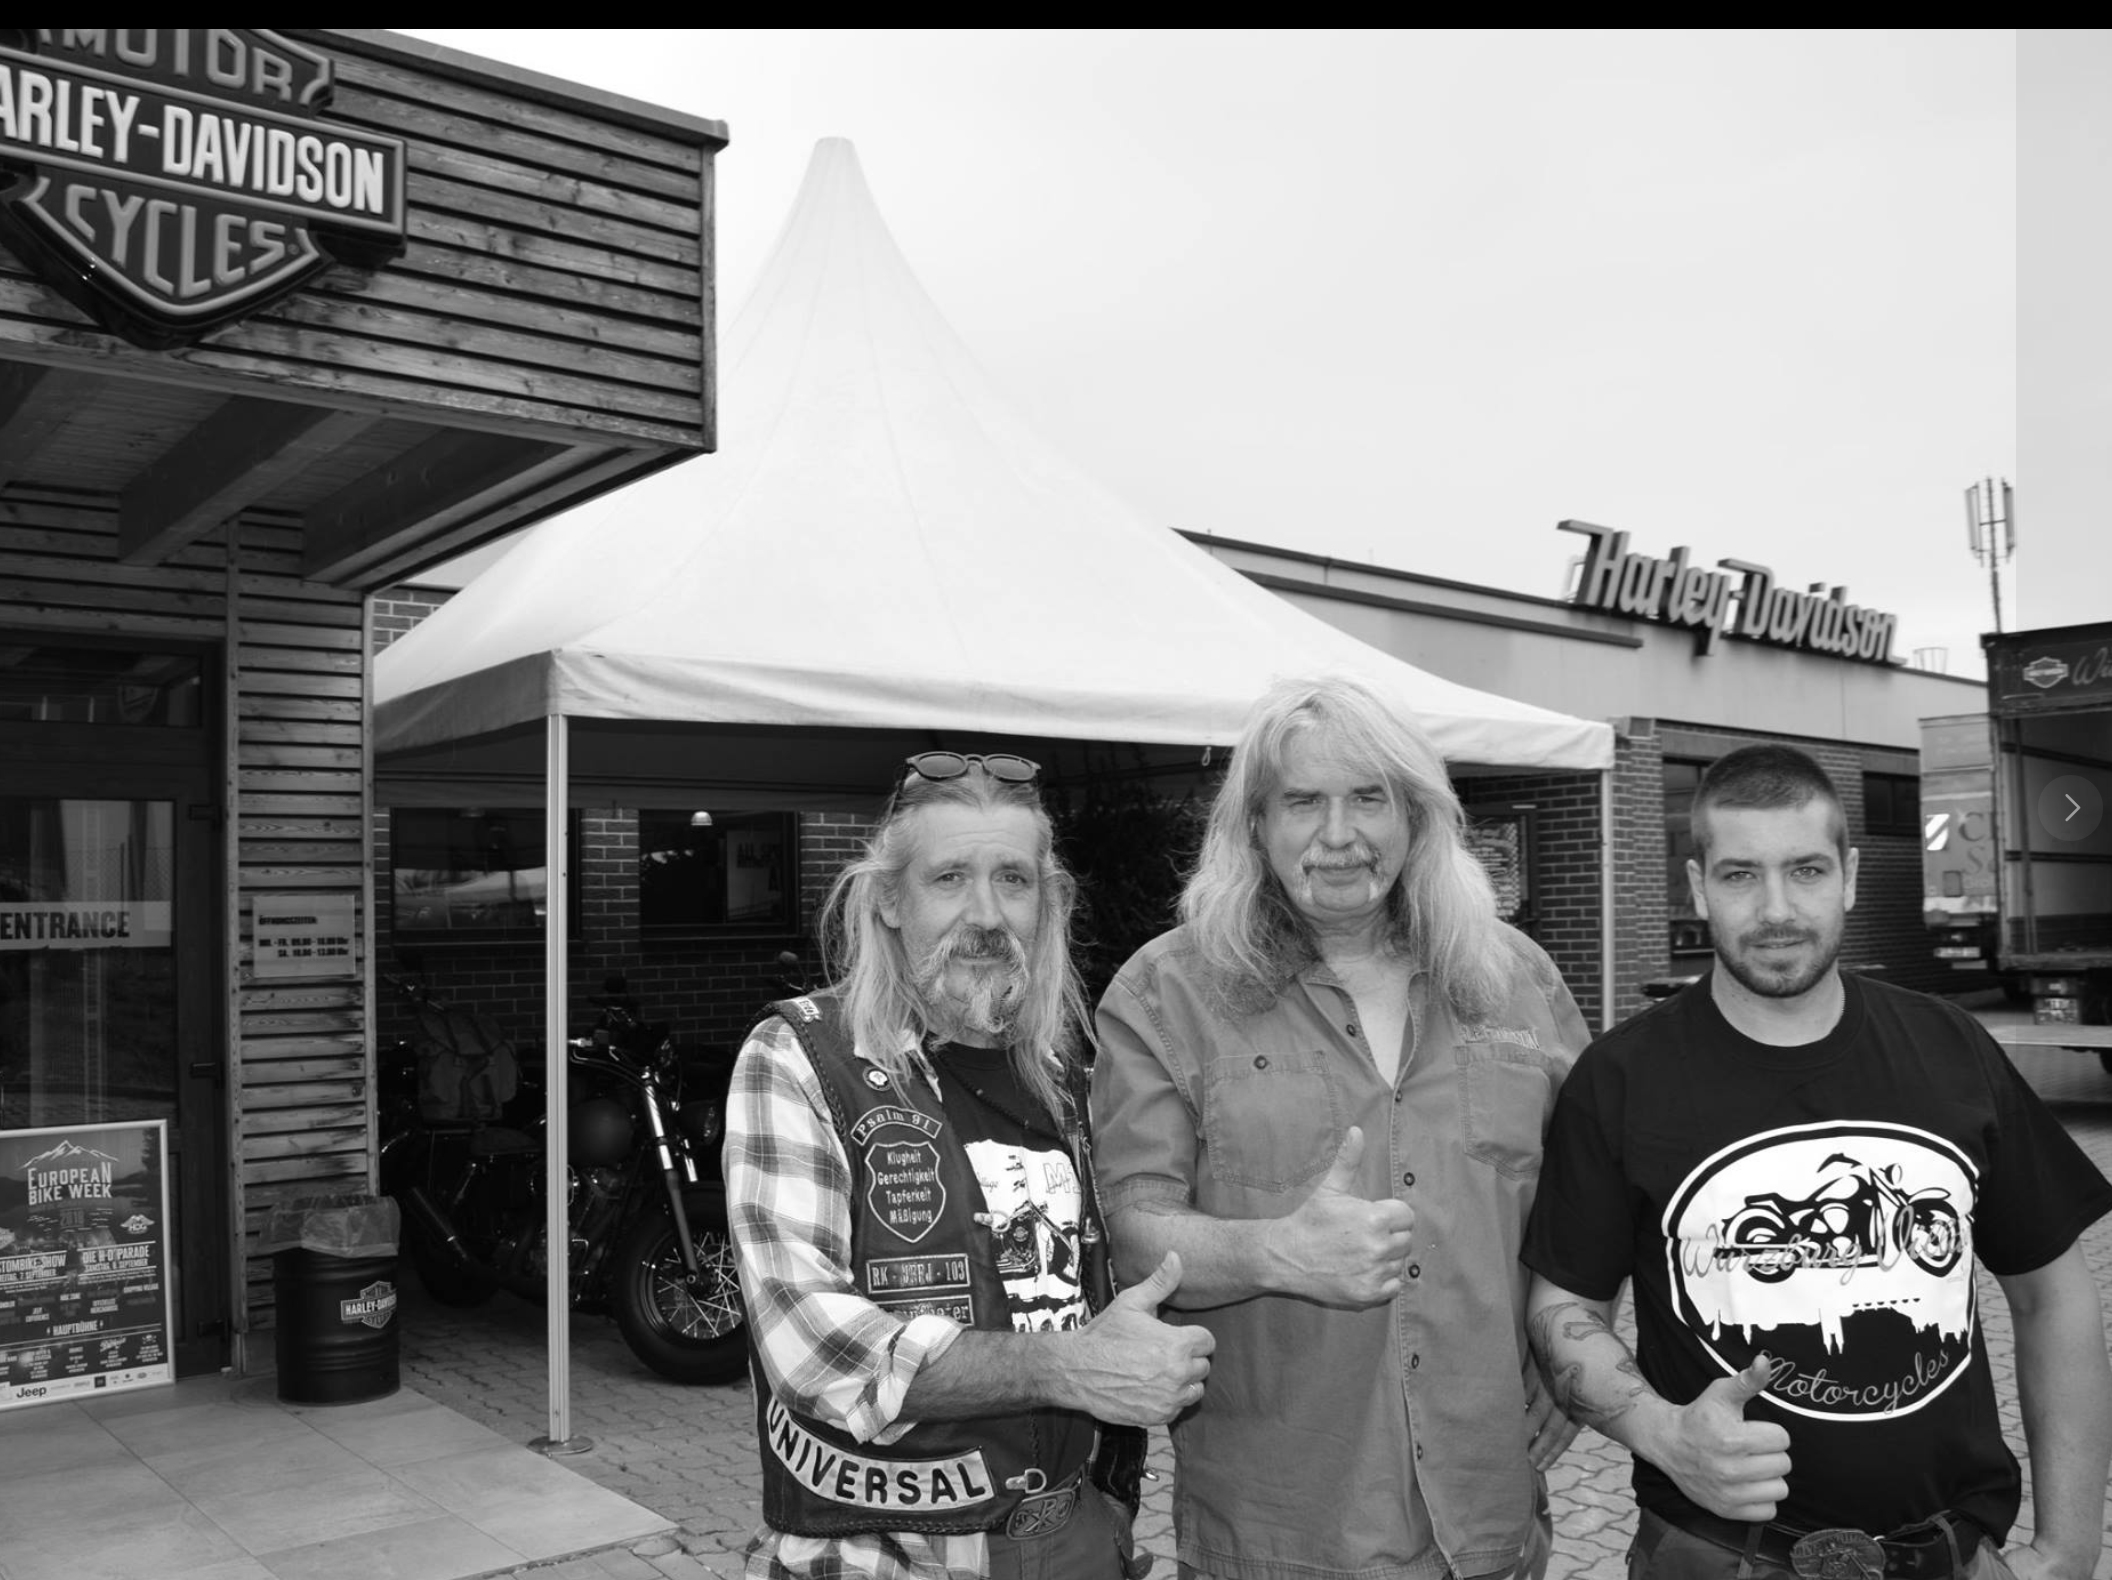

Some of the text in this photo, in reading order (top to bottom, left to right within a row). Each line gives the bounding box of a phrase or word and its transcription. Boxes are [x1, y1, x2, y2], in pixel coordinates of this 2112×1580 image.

[0, 64, 384, 214] ARLEY-DAVIDSON
[65, 184, 285, 298] CYCLES
[1557, 519, 1907, 666] Harley-Davidson
[0, 911, 130, 939] ENTRANCE
[856, 1109, 931, 1137] Psalm 91
[886, 1150, 922, 1166] Klugheit
[27, 1161, 112, 1190] EUROPEAN
[877, 1167, 935, 1185] Gerechtigkeit
[28, 1183, 112, 1206] BIKE WEEK
[886, 1186, 932, 1206] Tapferkeit
[117, 1245, 149, 1260] PARADE
[944, 1260, 965, 1281] 103
[16, 1386, 47, 1398] Jeep
[1760, 1349, 1949, 1414] Motorcycles
[768, 1400, 986, 1504] UNIVERSAL
